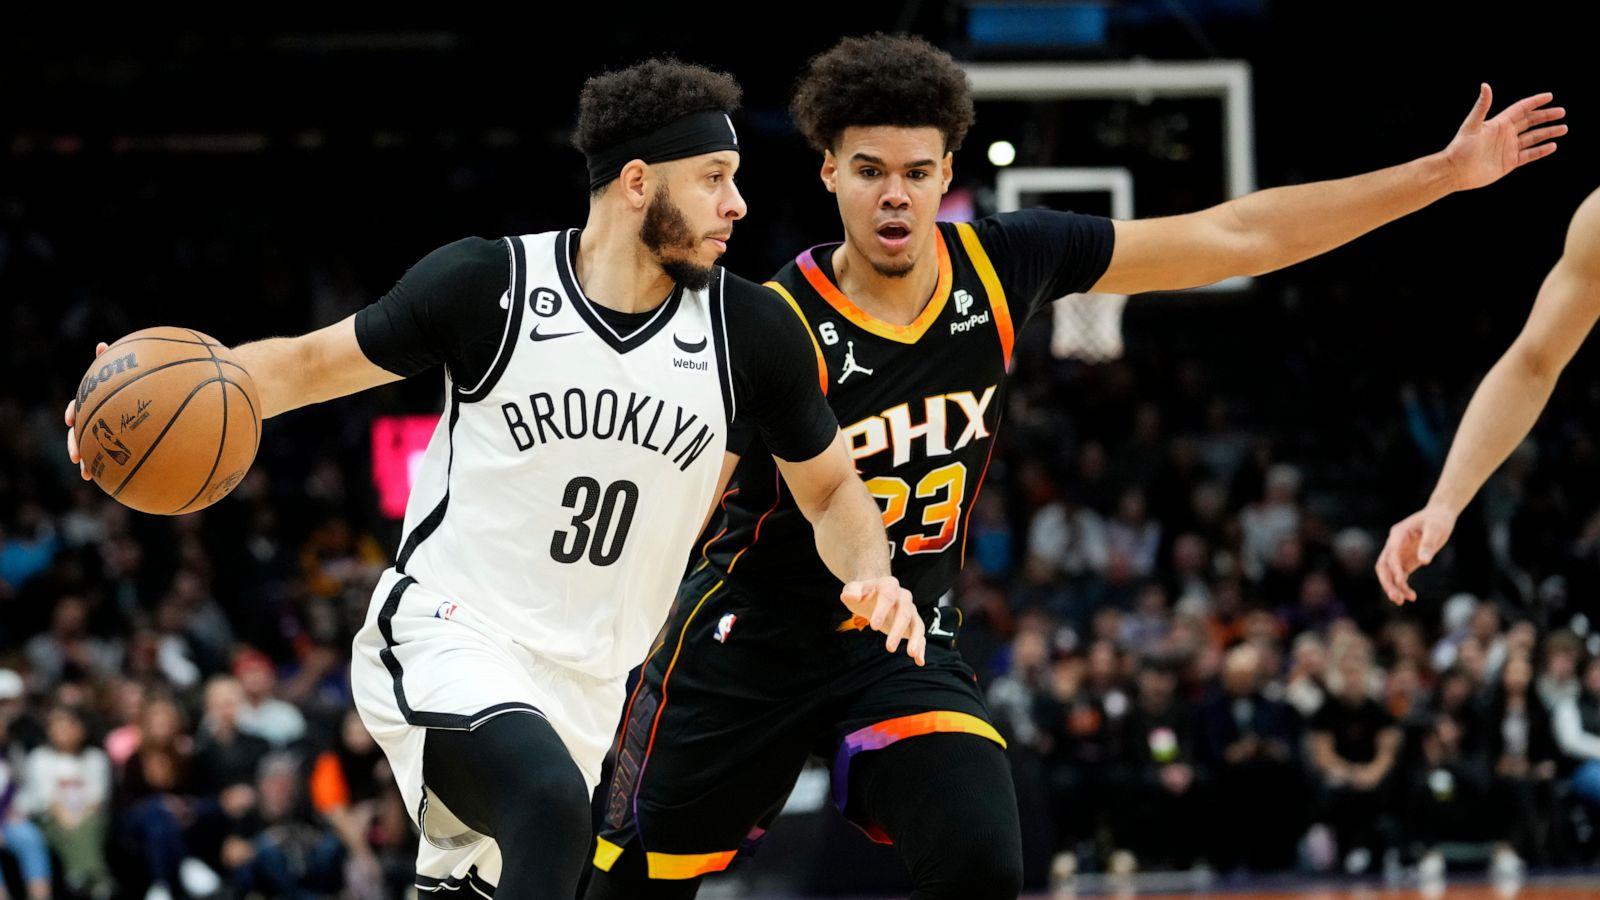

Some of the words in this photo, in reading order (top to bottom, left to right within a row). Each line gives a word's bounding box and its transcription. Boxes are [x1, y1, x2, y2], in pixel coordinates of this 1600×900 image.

[536, 291, 555, 315] 6
[818, 321, 839, 345] 6
[950, 310, 989, 335] PayPal
[673, 357, 708, 371] Webull
[501, 388, 715, 472] BROOKLYN
[841, 384, 998, 475] PHX
[549, 476, 640, 567] 30
